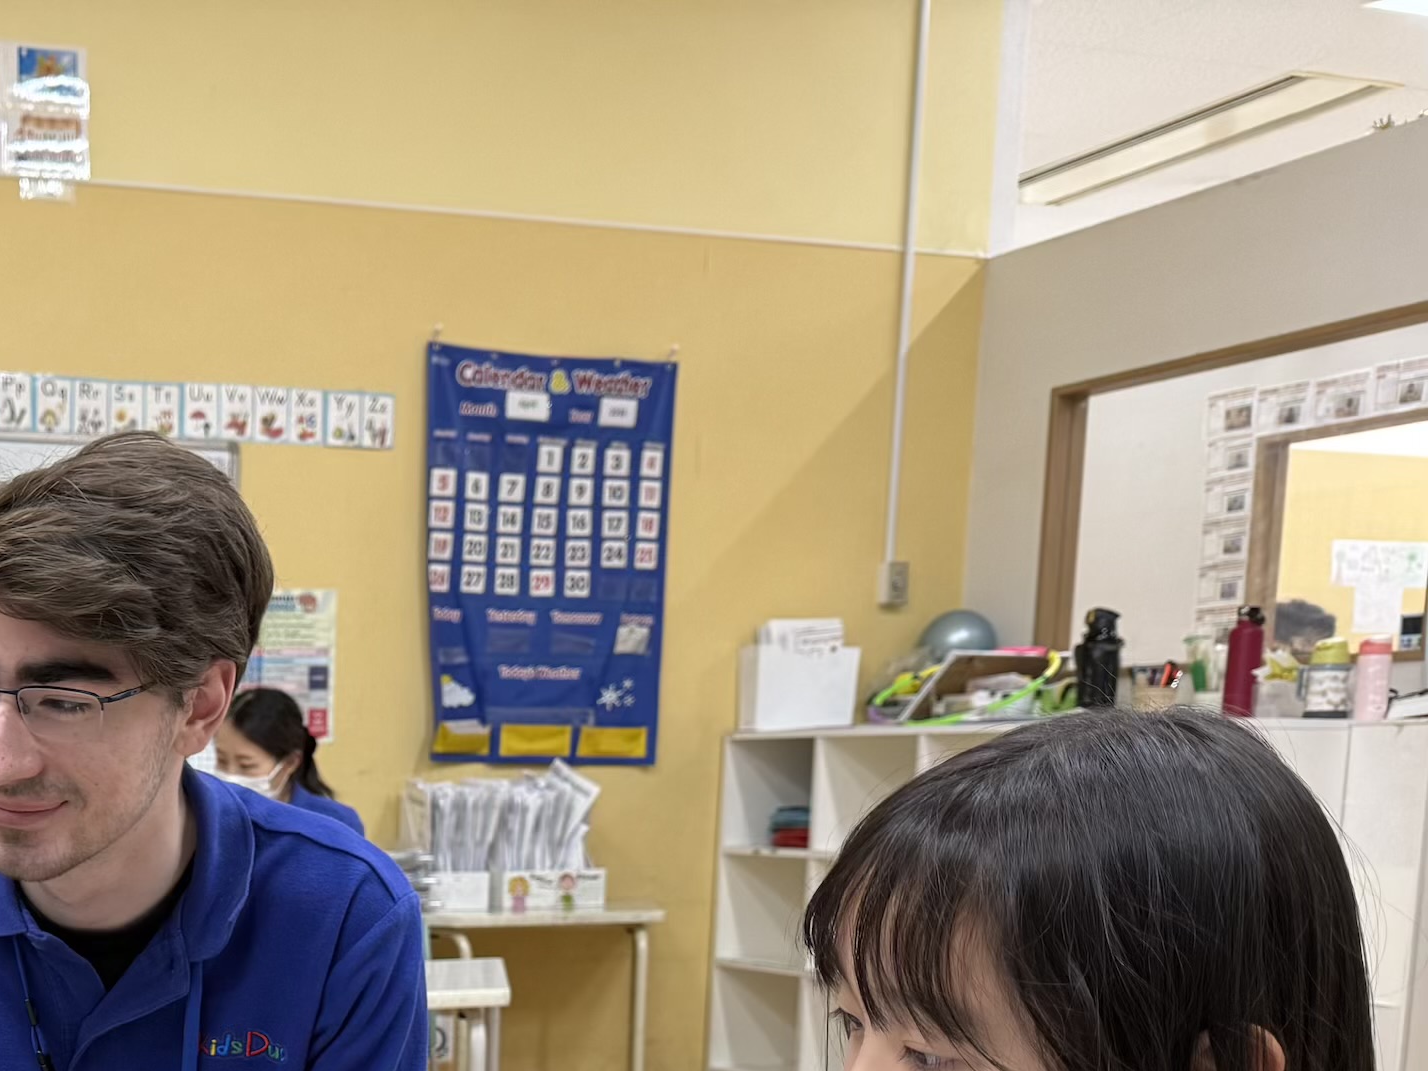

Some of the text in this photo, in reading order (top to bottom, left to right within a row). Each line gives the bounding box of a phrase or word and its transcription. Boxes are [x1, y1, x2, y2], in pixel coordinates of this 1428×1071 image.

[456, 360, 546, 392] Calendar
[550, 370, 571, 394] &
[572, 369, 652, 398] Weather
[578, 453, 588, 469] 2
[506, 480, 518, 494] 7
[575, 483, 586, 498] 9
